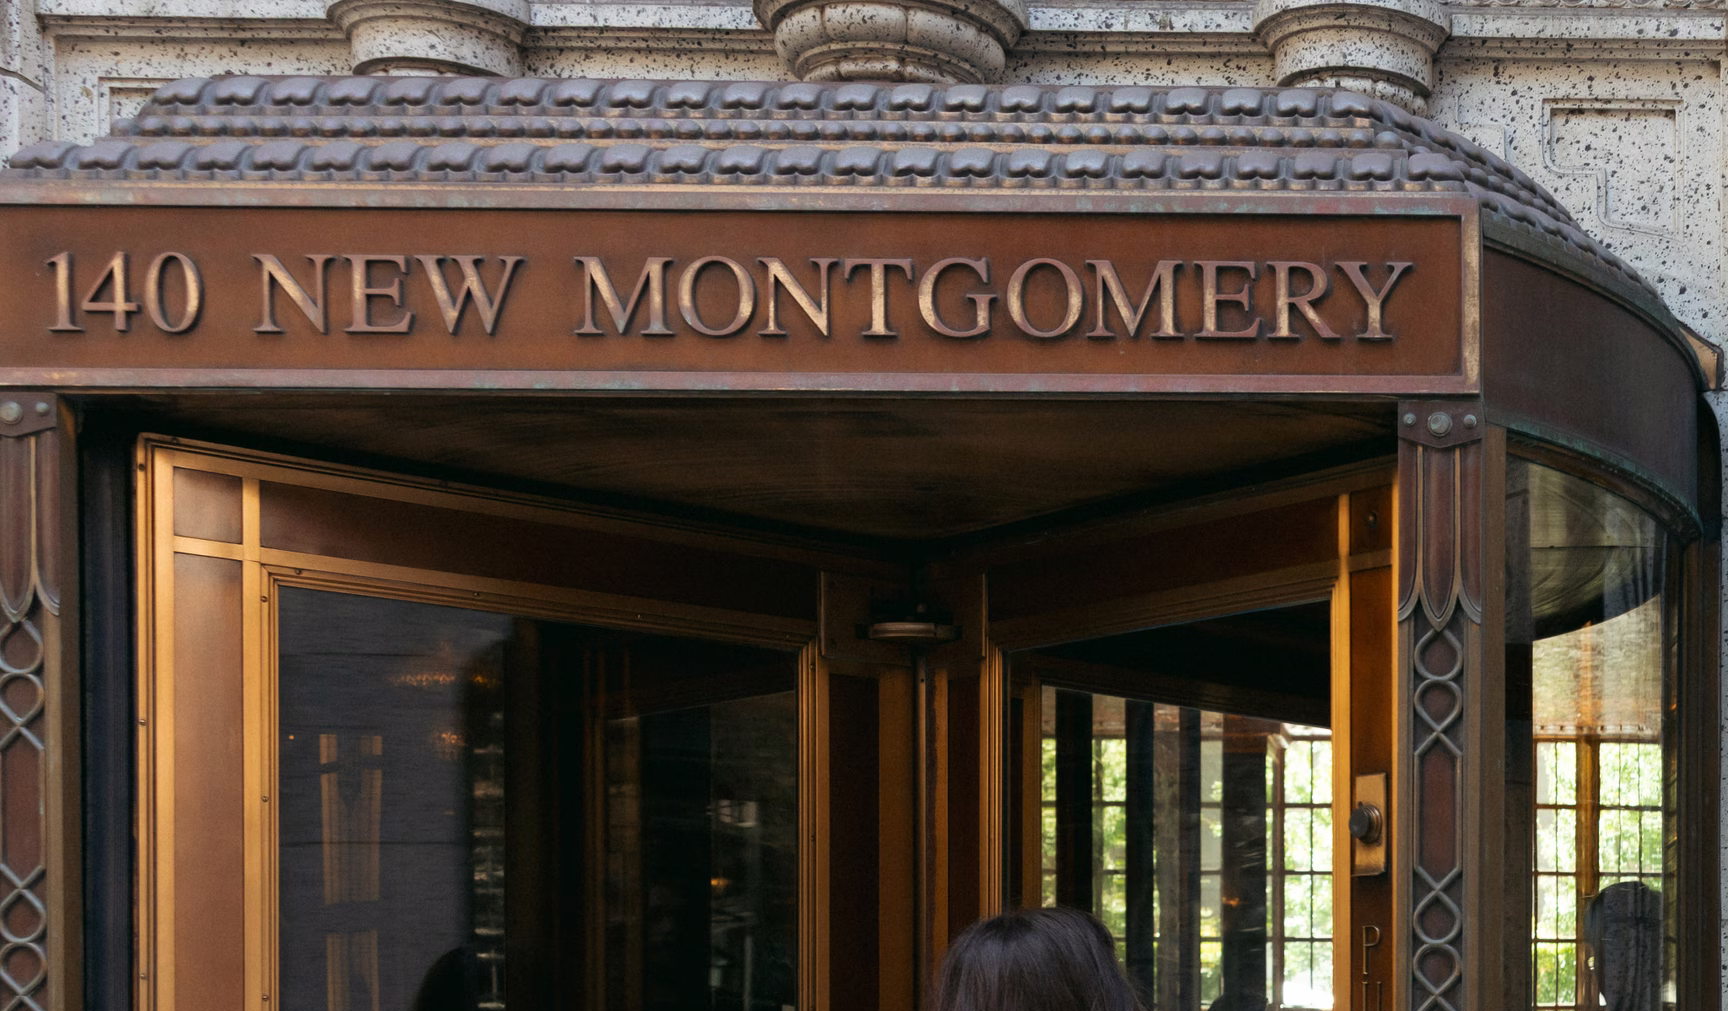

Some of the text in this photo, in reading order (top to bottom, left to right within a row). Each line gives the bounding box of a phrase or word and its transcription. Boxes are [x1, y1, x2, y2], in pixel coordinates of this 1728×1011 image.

[46, 251, 1413, 341] 140 NEW MONTGOMERY
